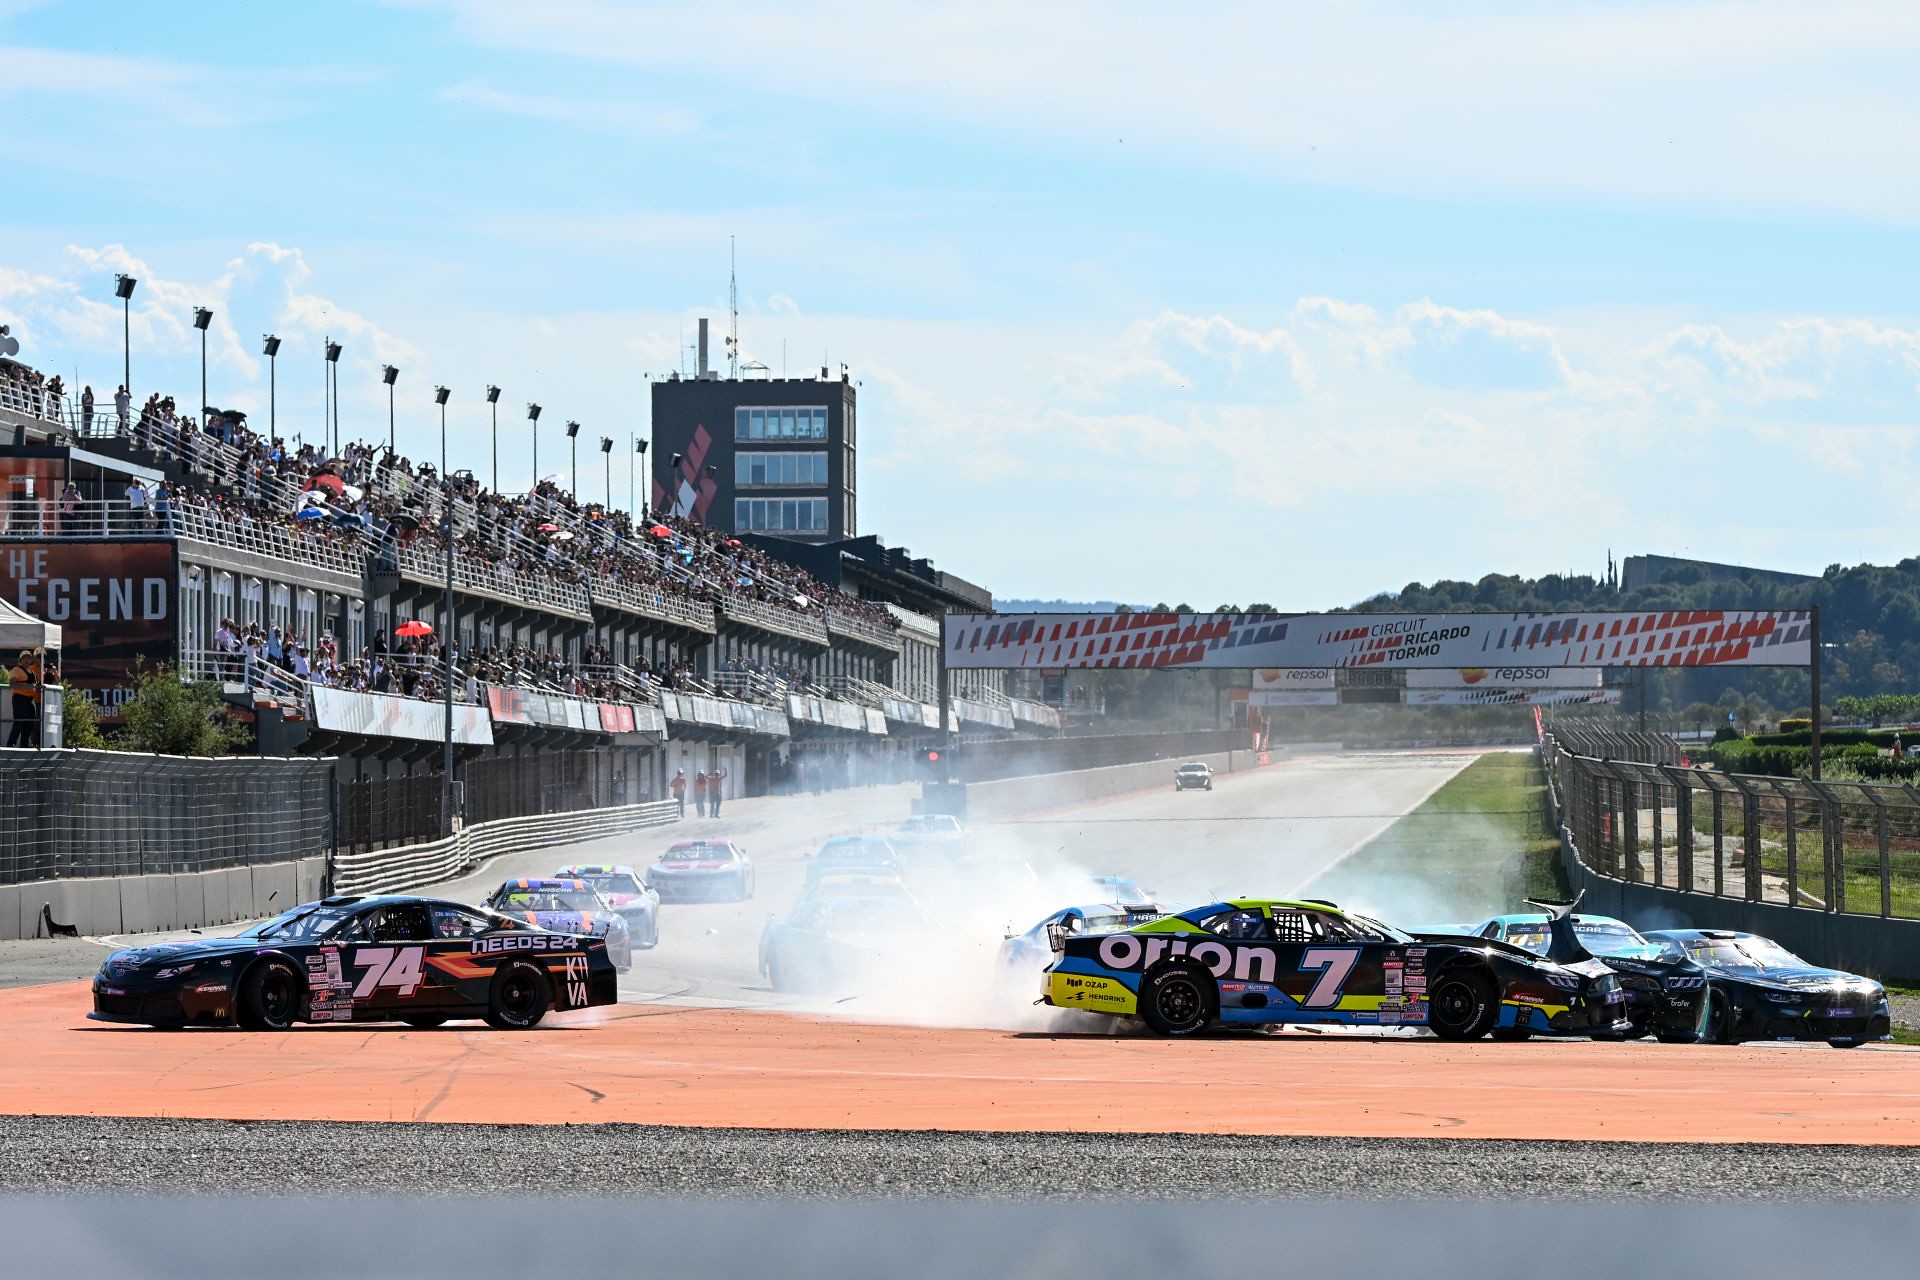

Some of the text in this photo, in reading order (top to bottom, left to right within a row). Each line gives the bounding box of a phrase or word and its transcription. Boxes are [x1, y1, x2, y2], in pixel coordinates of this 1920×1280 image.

[0, 550, 49, 578] HE
[19, 578, 167, 621] EGEND
[1371, 618, 1426, 637] CIRCUIT
[1404, 626, 1470, 645] RICARDO
[1388, 644, 1440, 661] TORMO
[1286, 668, 1329, 681] repsol
[1494, 668, 1550, 682] repsol
[1132, 913, 1172, 921] NASC
[549, 935, 579, 949] 24
[1099, 931, 1276, 983] orion
[353, 946, 426, 998] 74
[1300, 948, 1363, 1009] 7
[1085, 981, 1108, 989] OZAP
[1088, 994, 1126, 1003] HENDRIKS
